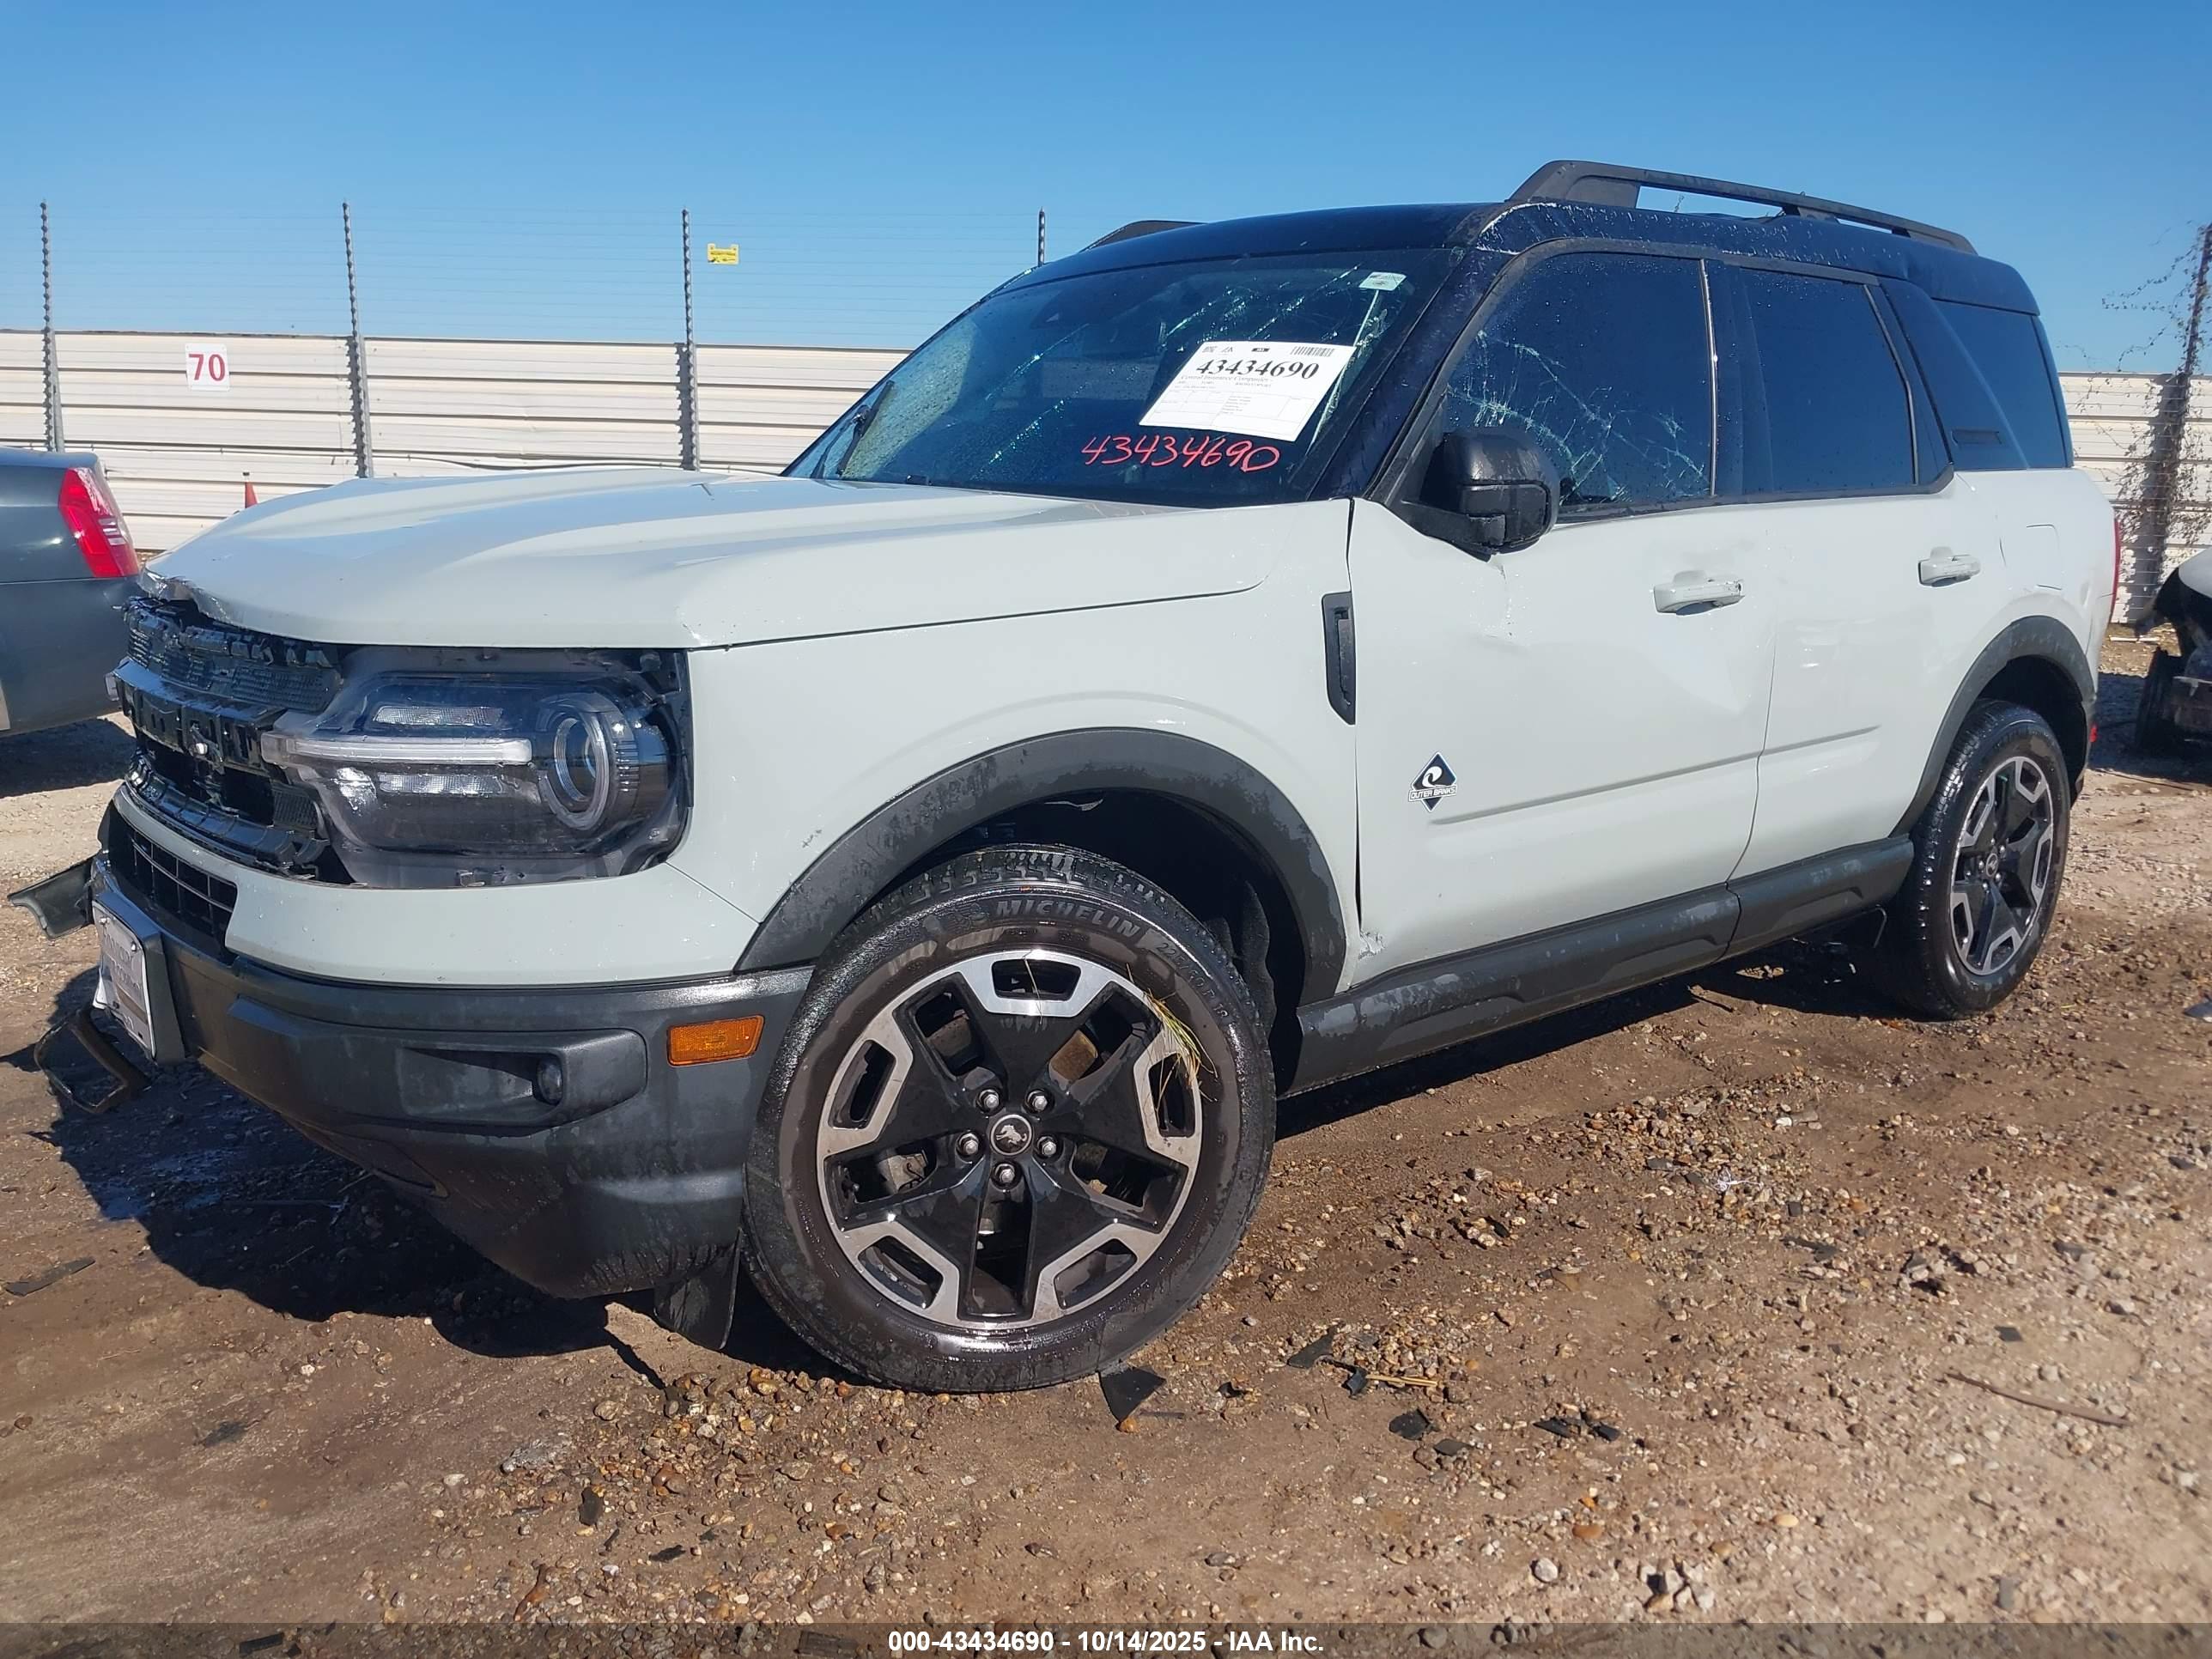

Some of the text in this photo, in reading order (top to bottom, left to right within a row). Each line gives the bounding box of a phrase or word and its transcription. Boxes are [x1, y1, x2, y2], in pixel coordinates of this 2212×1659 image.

[188, 353, 226, 381] 70
[1196, 359, 1320, 380] 43434690
[1081, 434, 1280, 472] 43434690
[1411, 787, 1456, 799] OUTER BANKS
[994, 899, 1141, 939] MICHELIN
